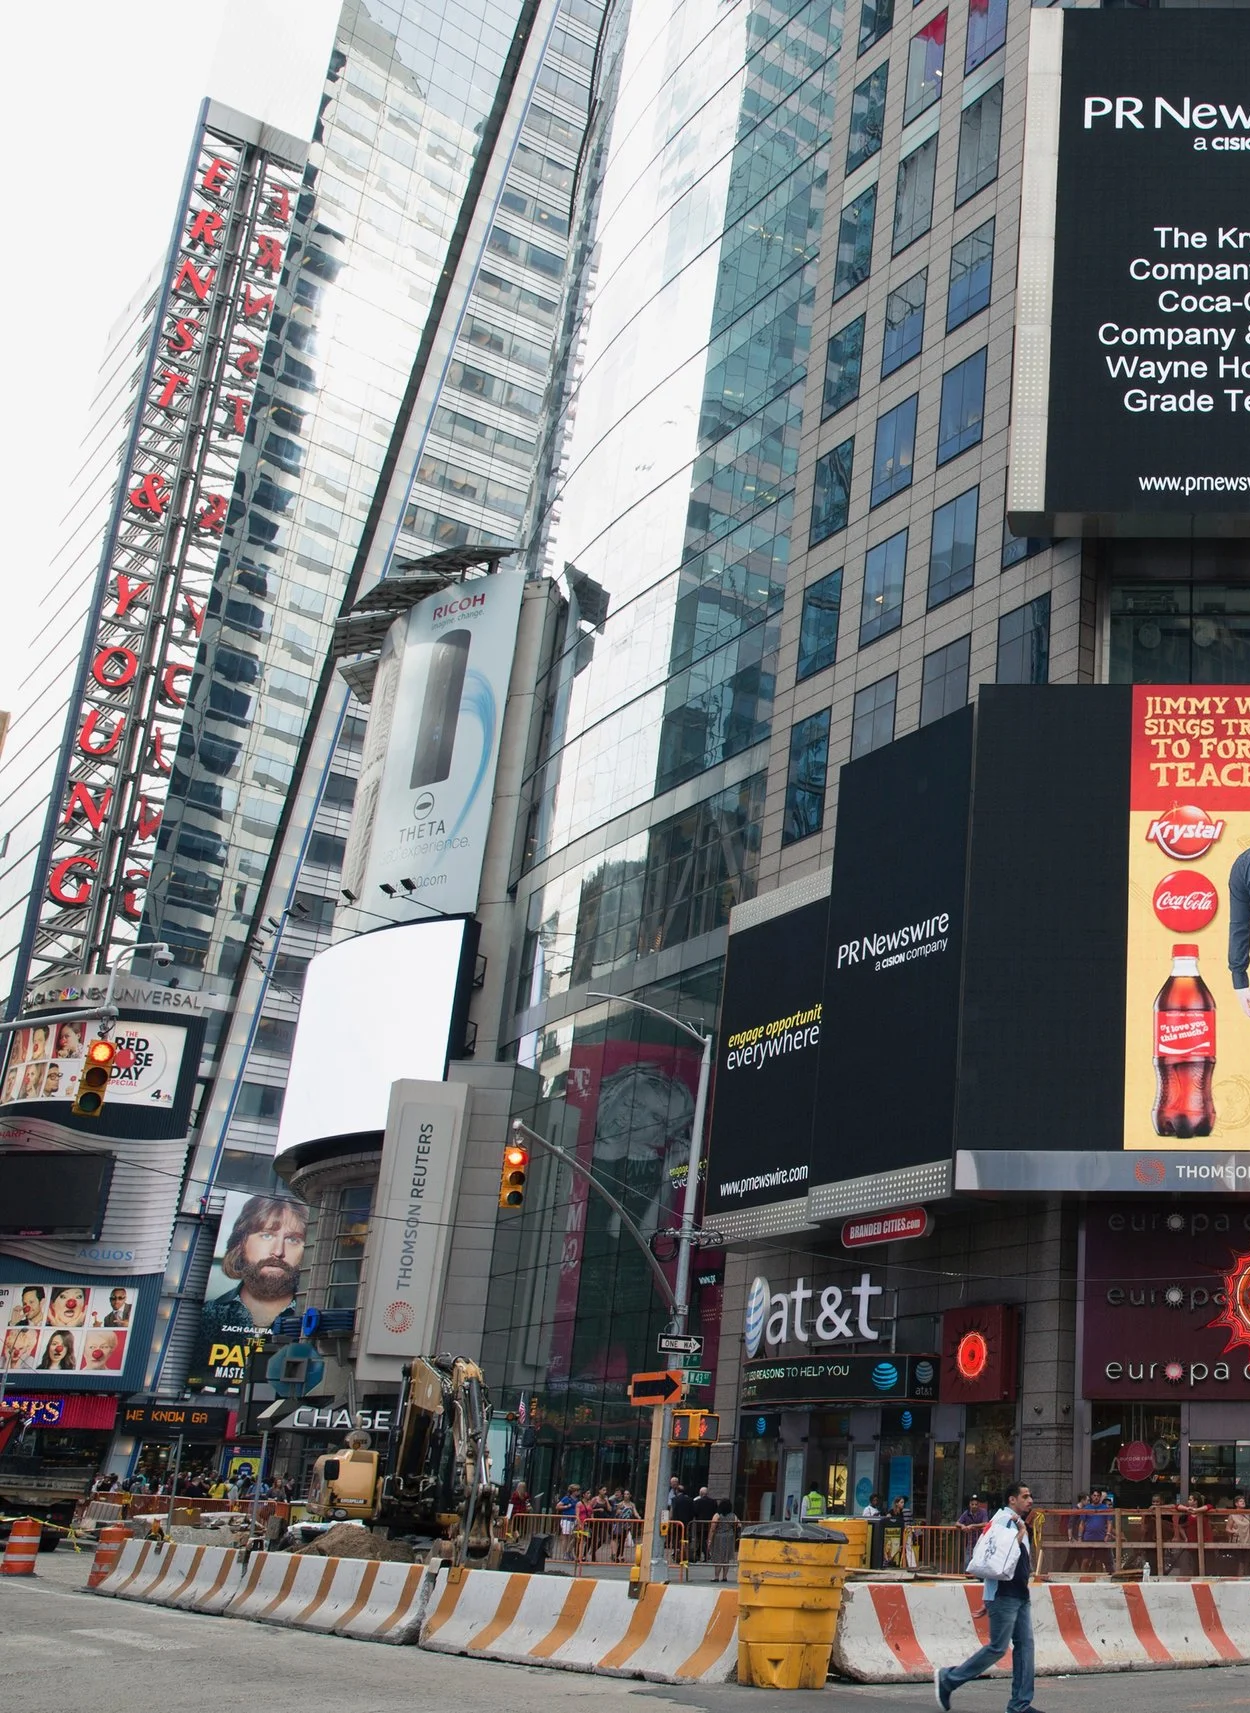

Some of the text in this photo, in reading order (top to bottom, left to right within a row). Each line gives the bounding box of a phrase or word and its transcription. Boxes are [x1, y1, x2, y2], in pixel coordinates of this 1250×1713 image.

[1083, 97, 1145, 130] PR
[1193, 137, 1208, 152] a
[1153, 227, 1208, 249] The
[1098, 323, 1237, 351] Company
[1105, 356, 1208, 384] Wayne
[1123, 389, 1215, 412] Grade
[50, 157, 234, 906] ERNST & YOUNG
[432, 593, 486, 621] RICOH
[457, 608, 486, 626] change.
[1145, 696, 1230, 719] JIMMY
[1144, 718, 1215, 739] SINGS
[1150, 738, 1191, 759] TO
[399, 820, 446, 844] THETA
[1148, 819, 1223, 845] Krystal
[401, 836, 471, 860] experience.
[837, 912, 950, 970] PR Newswire
[874, 937, 949, 972] a CISION company
[125, 1030, 139, 1038] THE
[728, 1003, 823, 1049] engage opportunit
[1170, 1022, 1190, 1034] love
[1189, 1020, 1207, 1031] you
[114, 1037, 149, 1051] RED
[726, 1024, 820, 1070] everywhere
[1160, 1032, 1178, 1043] this
[109, 1066, 144, 1081] DAY
[151, 1089, 162, 1100] 4
[0, 1129, 26, 1138] HARP
[720, 1164, 809, 1198] www.prnewswire.com
[396, 1121, 434, 1291] THOMSON REUTERS
[849, 1217, 921, 1240] BRANDED CITIES.com
[77, 1248, 134, 1262] AQUOS
[765, 1273, 883, 1346] at&t
[221, 1325, 273, 1335] ZACH GALIFIA
[246, 1337, 266, 1348] THE
[664, 1340, 697, 1349] ONE WAY
[689, 1371, 696, 1383] W
[695, 1372, 704, 1384] 43
[757, 1367, 785, 1380] REASONS
[786, 1367, 799, 1378] TO
[800, 1365, 825, 1377] HELP
[826, 1365, 850, 1377] YOU
[915, 1385, 934, 1396] at&t
[126, 1409, 145, 1421] WE
[151, 1410, 186, 1423] KNOW
[293, 1408, 393, 1430] CHASE
